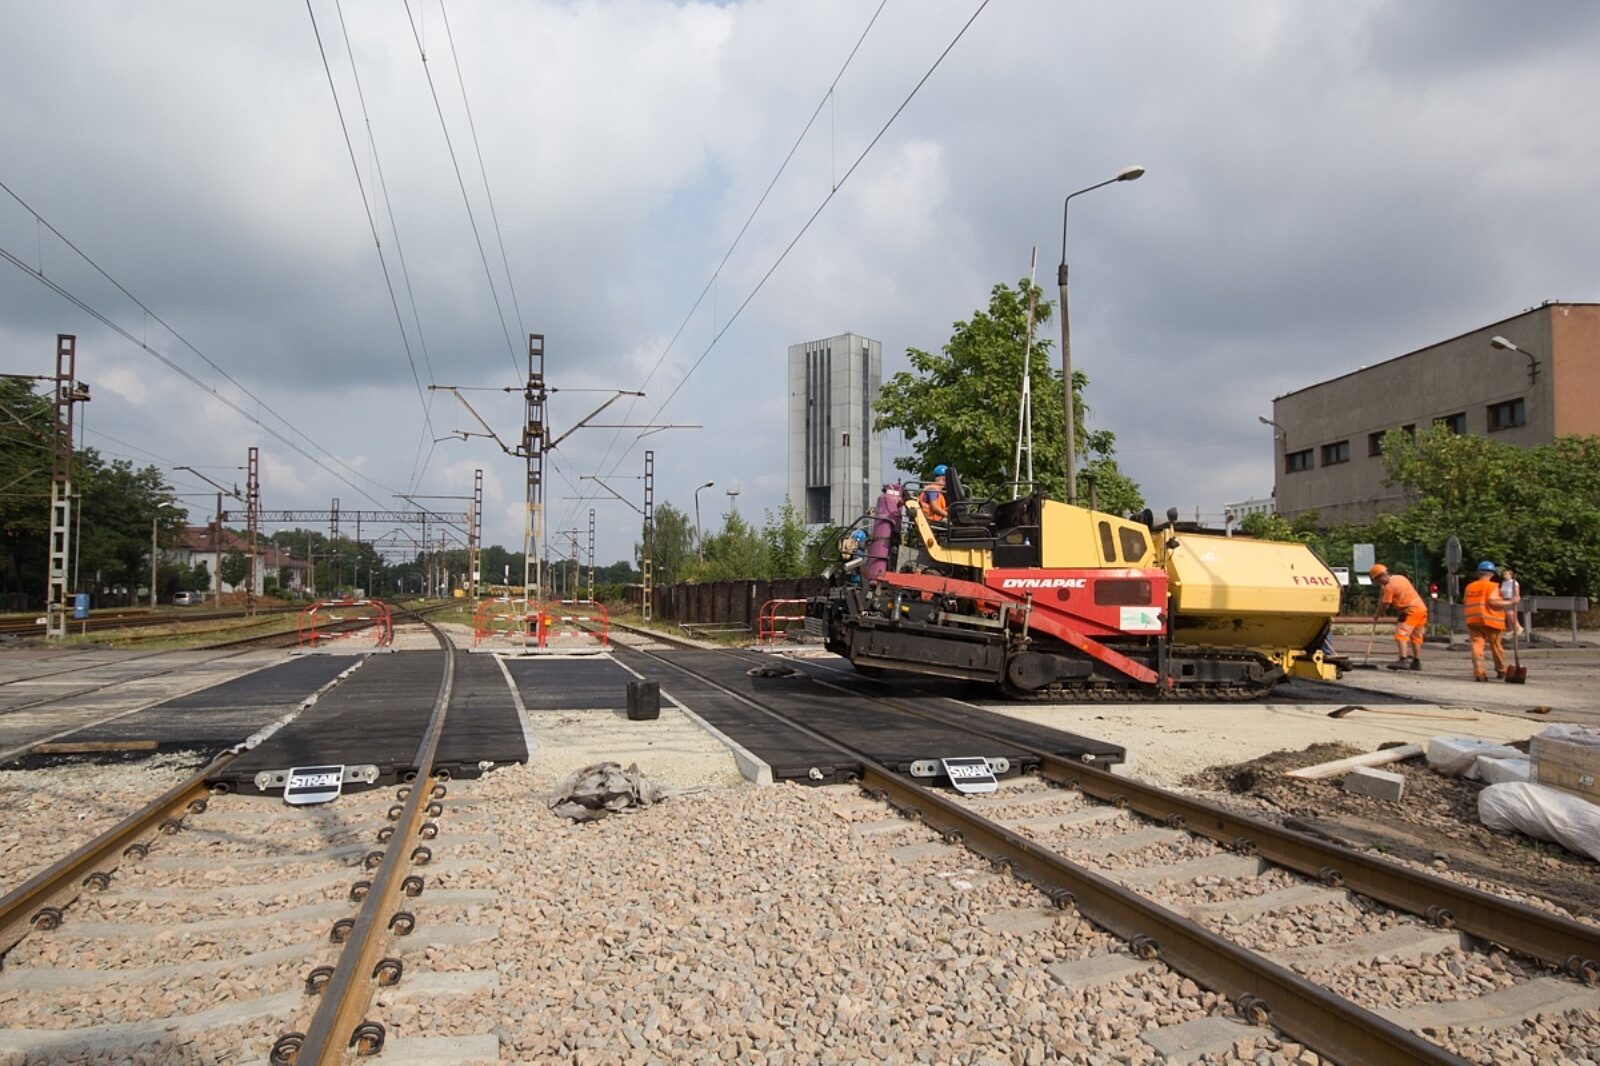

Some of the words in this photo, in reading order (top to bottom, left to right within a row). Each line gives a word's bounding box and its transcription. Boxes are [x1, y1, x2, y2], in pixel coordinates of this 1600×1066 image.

[1002, 578, 1087, 588] DYNAPAC
[1292, 576, 1299, 585] F
[950, 765, 992, 777] STRAIL
[290, 774, 340, 788] STRAIL
